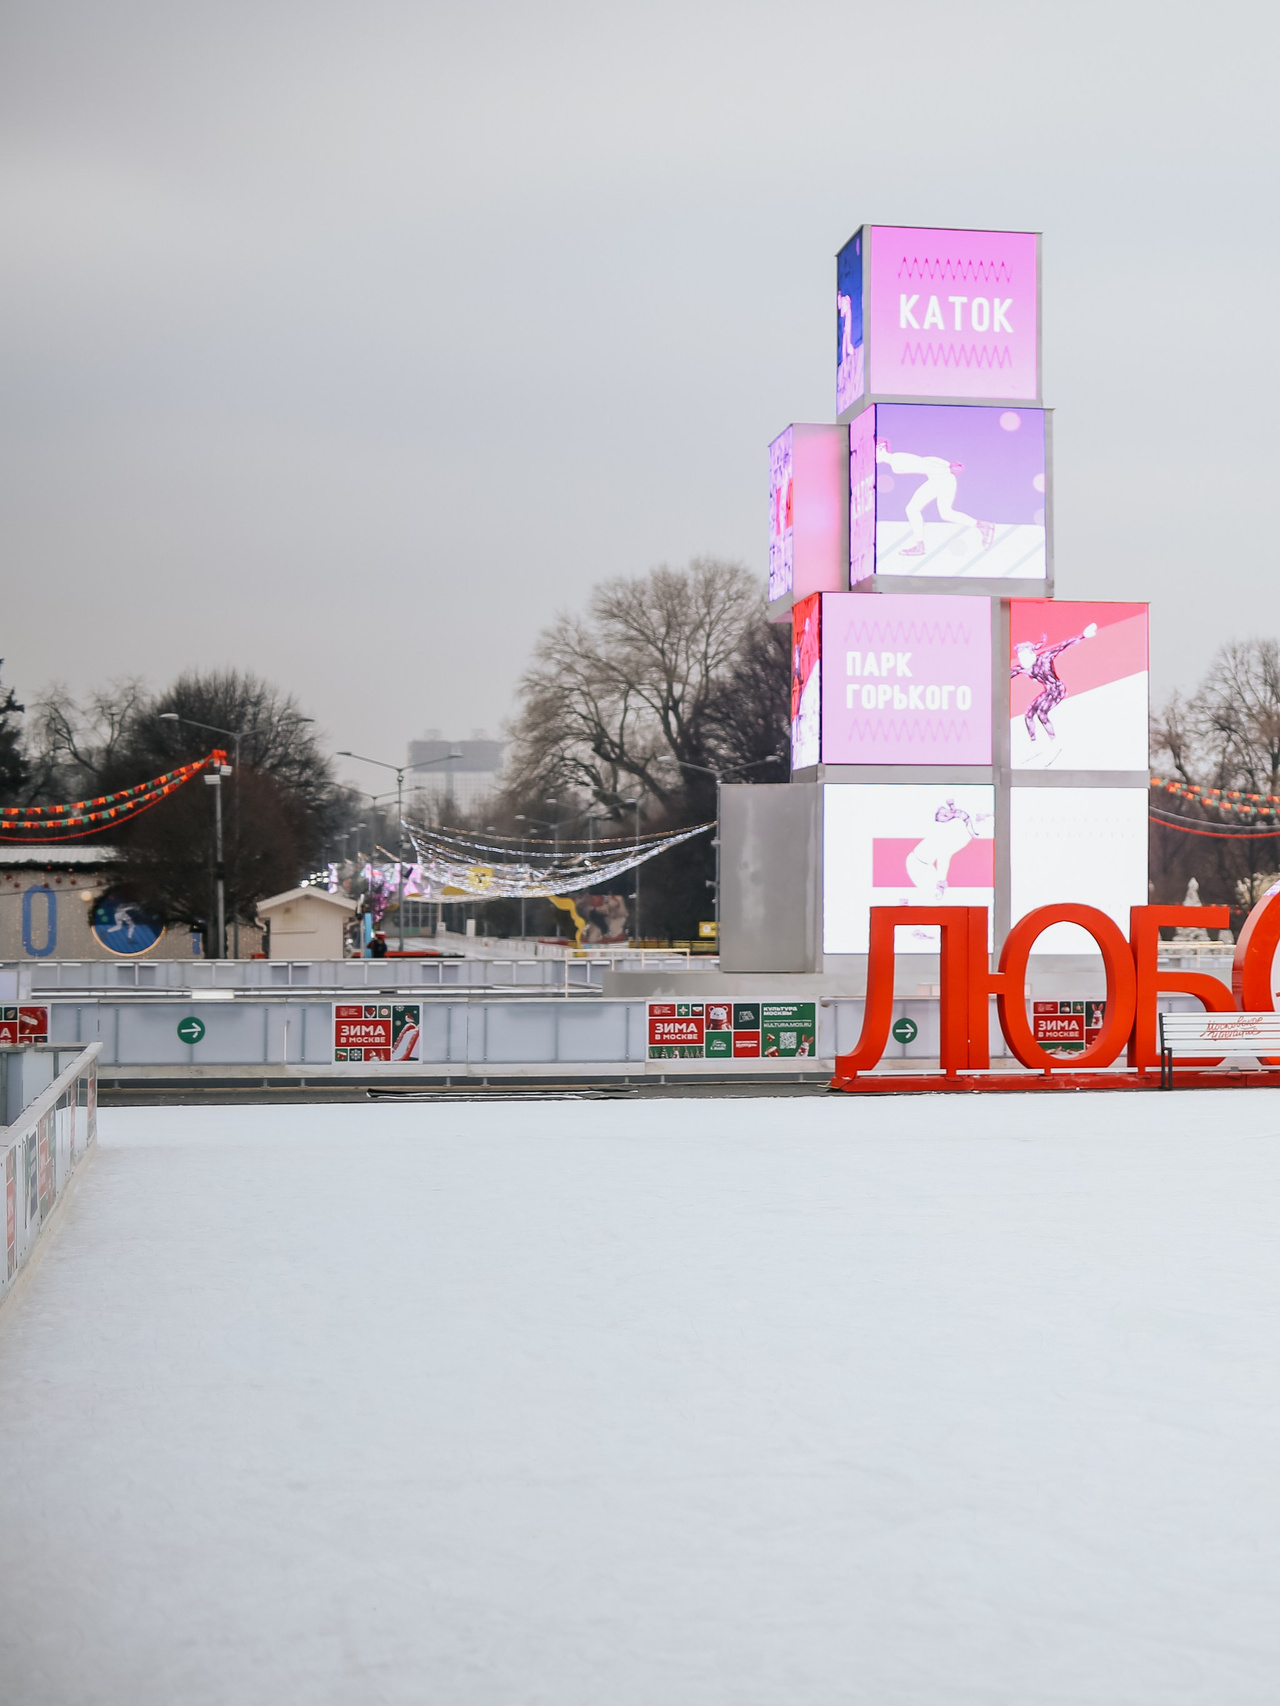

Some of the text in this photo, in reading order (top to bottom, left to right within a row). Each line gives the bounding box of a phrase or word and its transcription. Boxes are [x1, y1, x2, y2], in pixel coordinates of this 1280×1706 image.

[899, 293, 1014, 334] КАТОК
[846, 651, 913, 678] ПАРК
[846, 683, 972, 711] ГОРЬКОГО
[340, 1025, 386, 1036] ЗИМА
[654, 1022, 698, 1033] ЗИМА
[1038, 1020, 1079, 1030] ЗИМА
